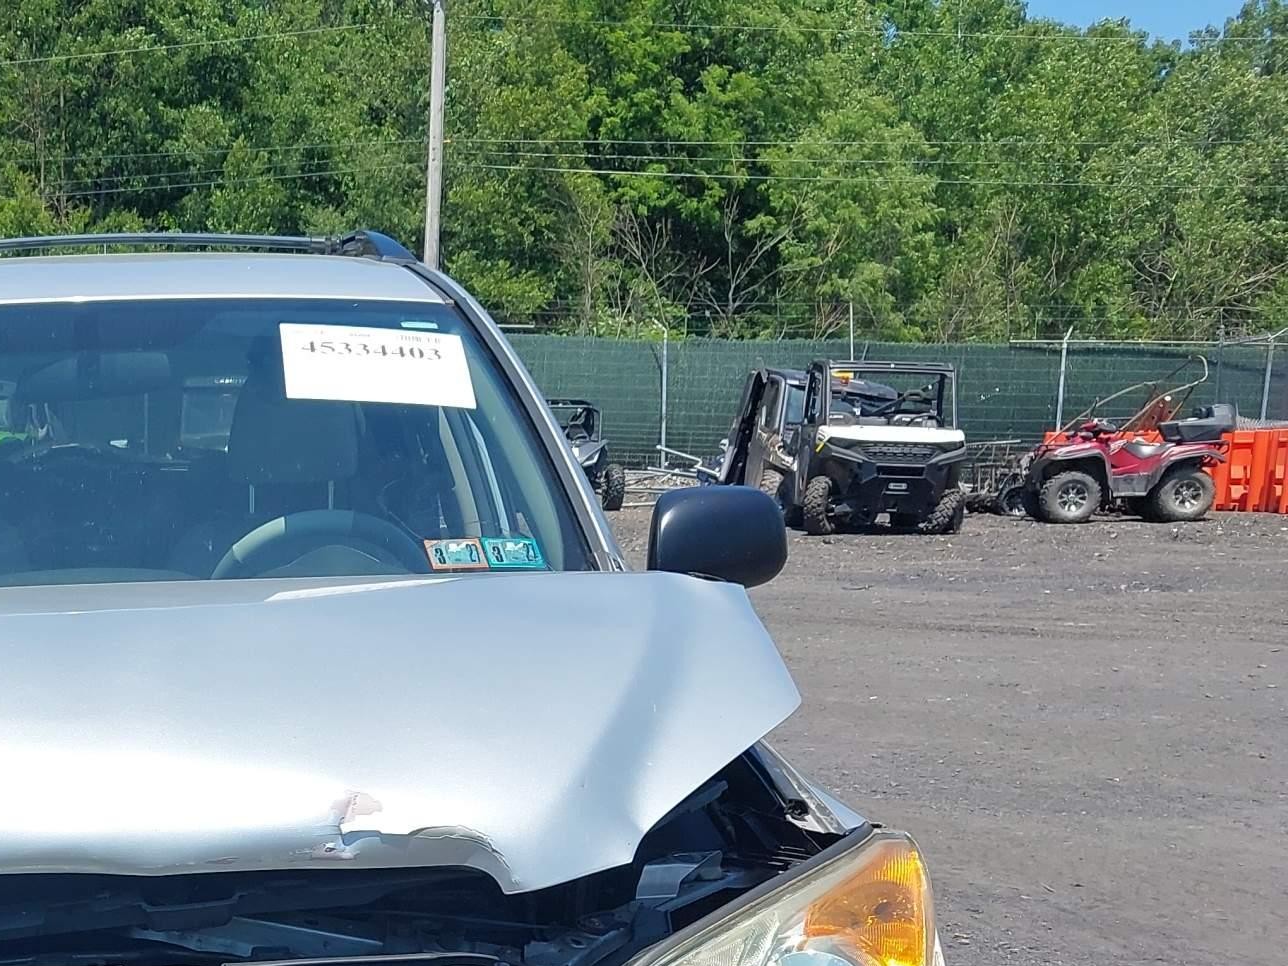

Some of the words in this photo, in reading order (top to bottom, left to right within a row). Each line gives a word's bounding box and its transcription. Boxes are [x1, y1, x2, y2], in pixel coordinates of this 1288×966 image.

[301, 340, 442, 361] 45334403
[434, 547, 447, 565] 3
[491, 545, 505, 563] 3
